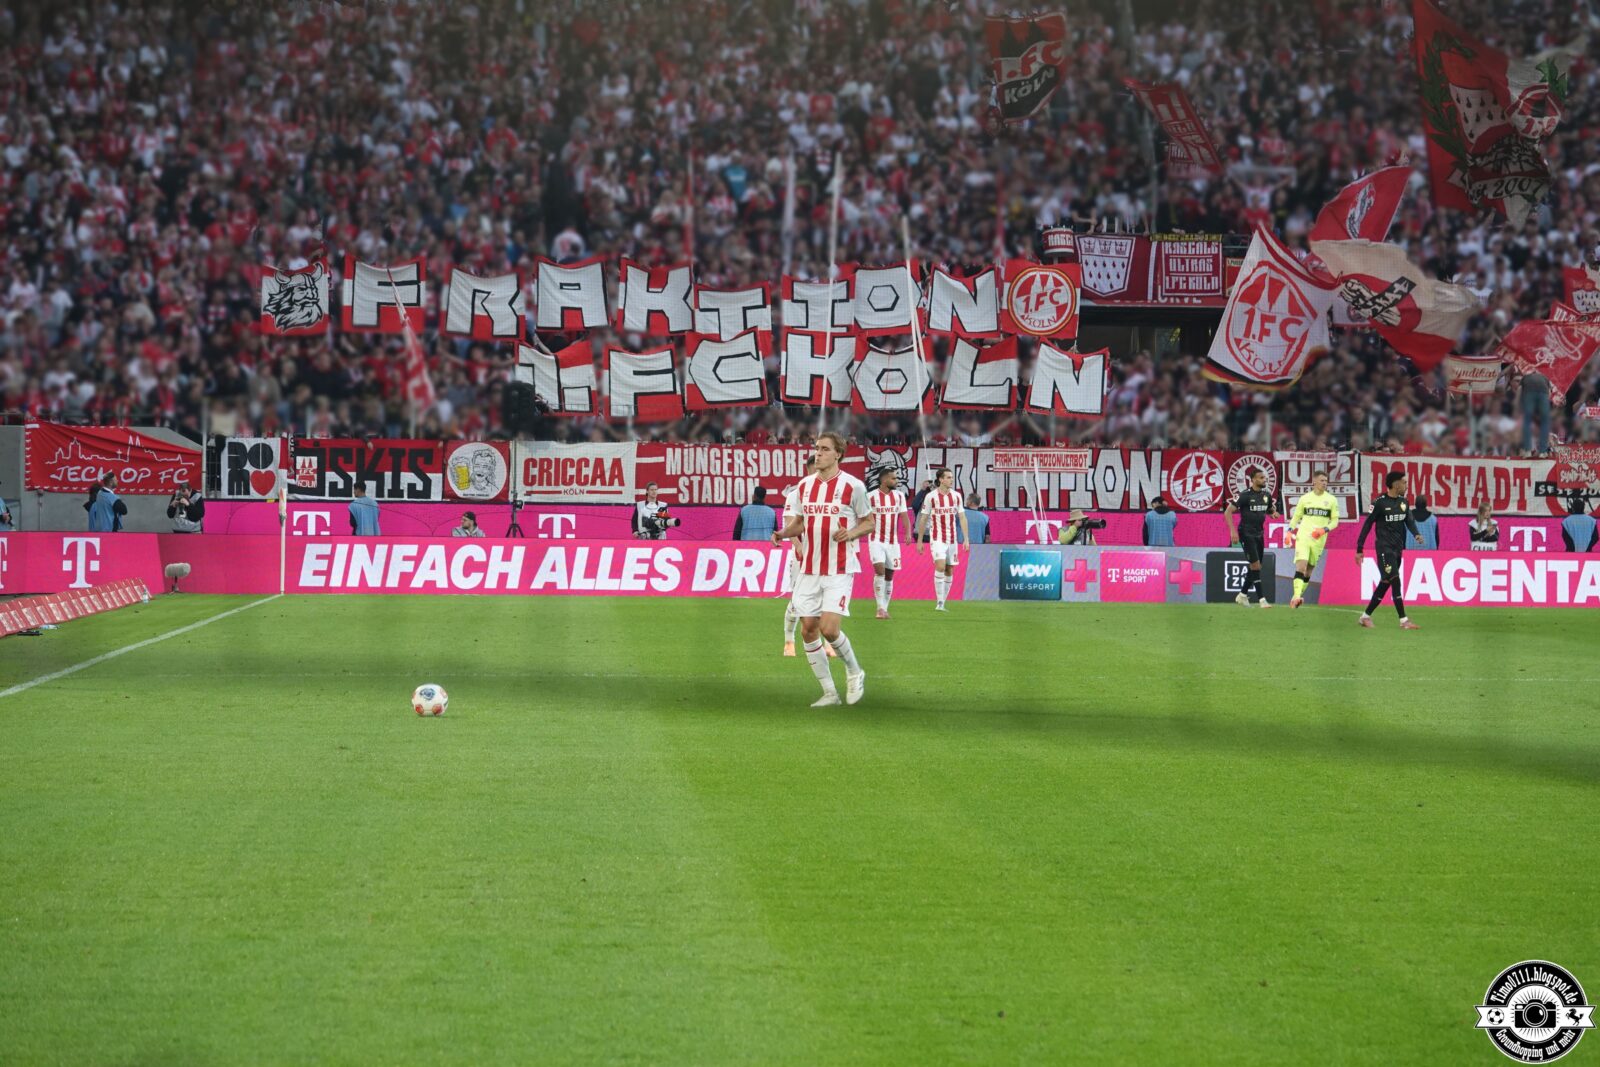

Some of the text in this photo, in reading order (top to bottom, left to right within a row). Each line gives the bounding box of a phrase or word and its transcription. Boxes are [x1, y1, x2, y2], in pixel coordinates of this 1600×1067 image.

[1169, 258, 1213, 272] ULTRAS
[353, 258, 998, 342] FRAKTION
[1022, 288, 1062, 314] 1.FC
[1243, 306, 1304, 343] 1.FC
[994, 452, 1029, 468] FRAKTION
[120, 467, 151, 484] OP
[159, 468, 190, 484] FC
[523, 457, 625, 487] CRICCAA
[1178, 470, 1217, 497] 1.FC
[804, 505, 829, 515] REWE
[299, 543, 525, 590] EINFACH
[531, 546, 683, 592] ALLES
[1010, 564, 1052, 578] WOW
[1123, 568, 1159, 577] MAGENTA
[1123, 576, 1147, 584] SPORT
[838, 595, 846, 611] 4
